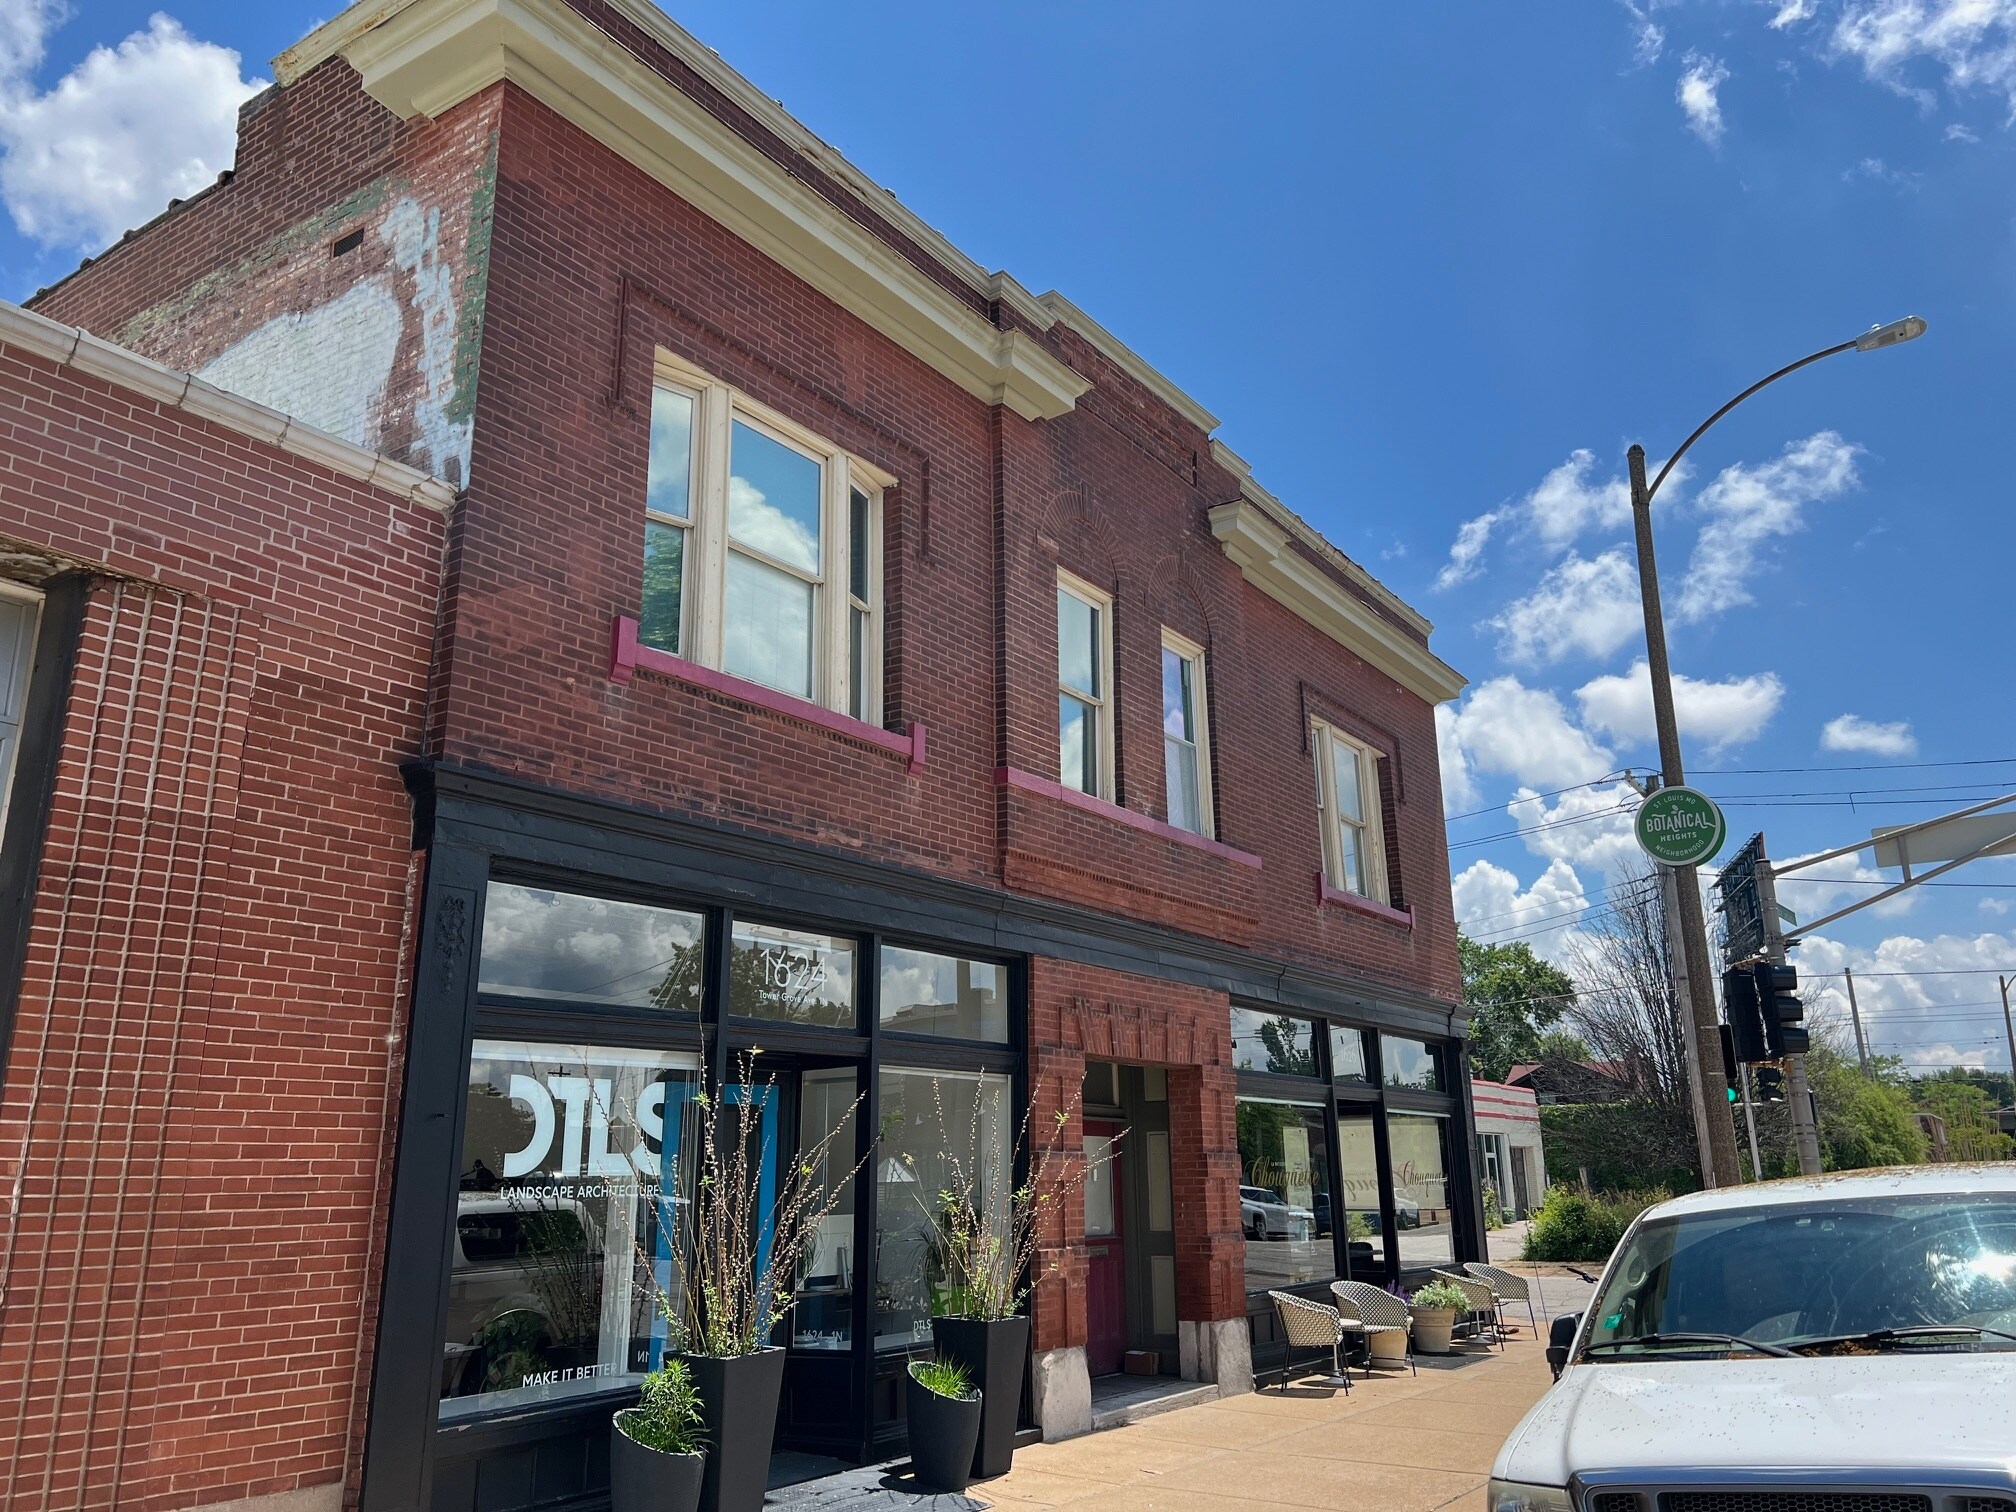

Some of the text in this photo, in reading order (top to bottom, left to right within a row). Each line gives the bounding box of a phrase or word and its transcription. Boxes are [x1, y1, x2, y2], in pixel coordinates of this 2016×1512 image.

[1664, 795, 1684, 803] LOUIS
[1686, 796, 1696, 805] MO
[1645, 810, 1716, 833] BOTANICAL
[1660, 832, 1697, 842] HEIGHTS
[1655, 839, 1705, 857] NEIGHBORHOOD
[760, 948, 828, 992] 1624
[759, 990, 779, 1000] Tower
[781, 993, 801, 1002] Grove
[503, 1074, 666, 1177] DTLS
[500, 1184, 661, 1200] LANDSCAPE ARCHITECTURE
[522, 1362, 618, 1388] MAKE IT BETTER
